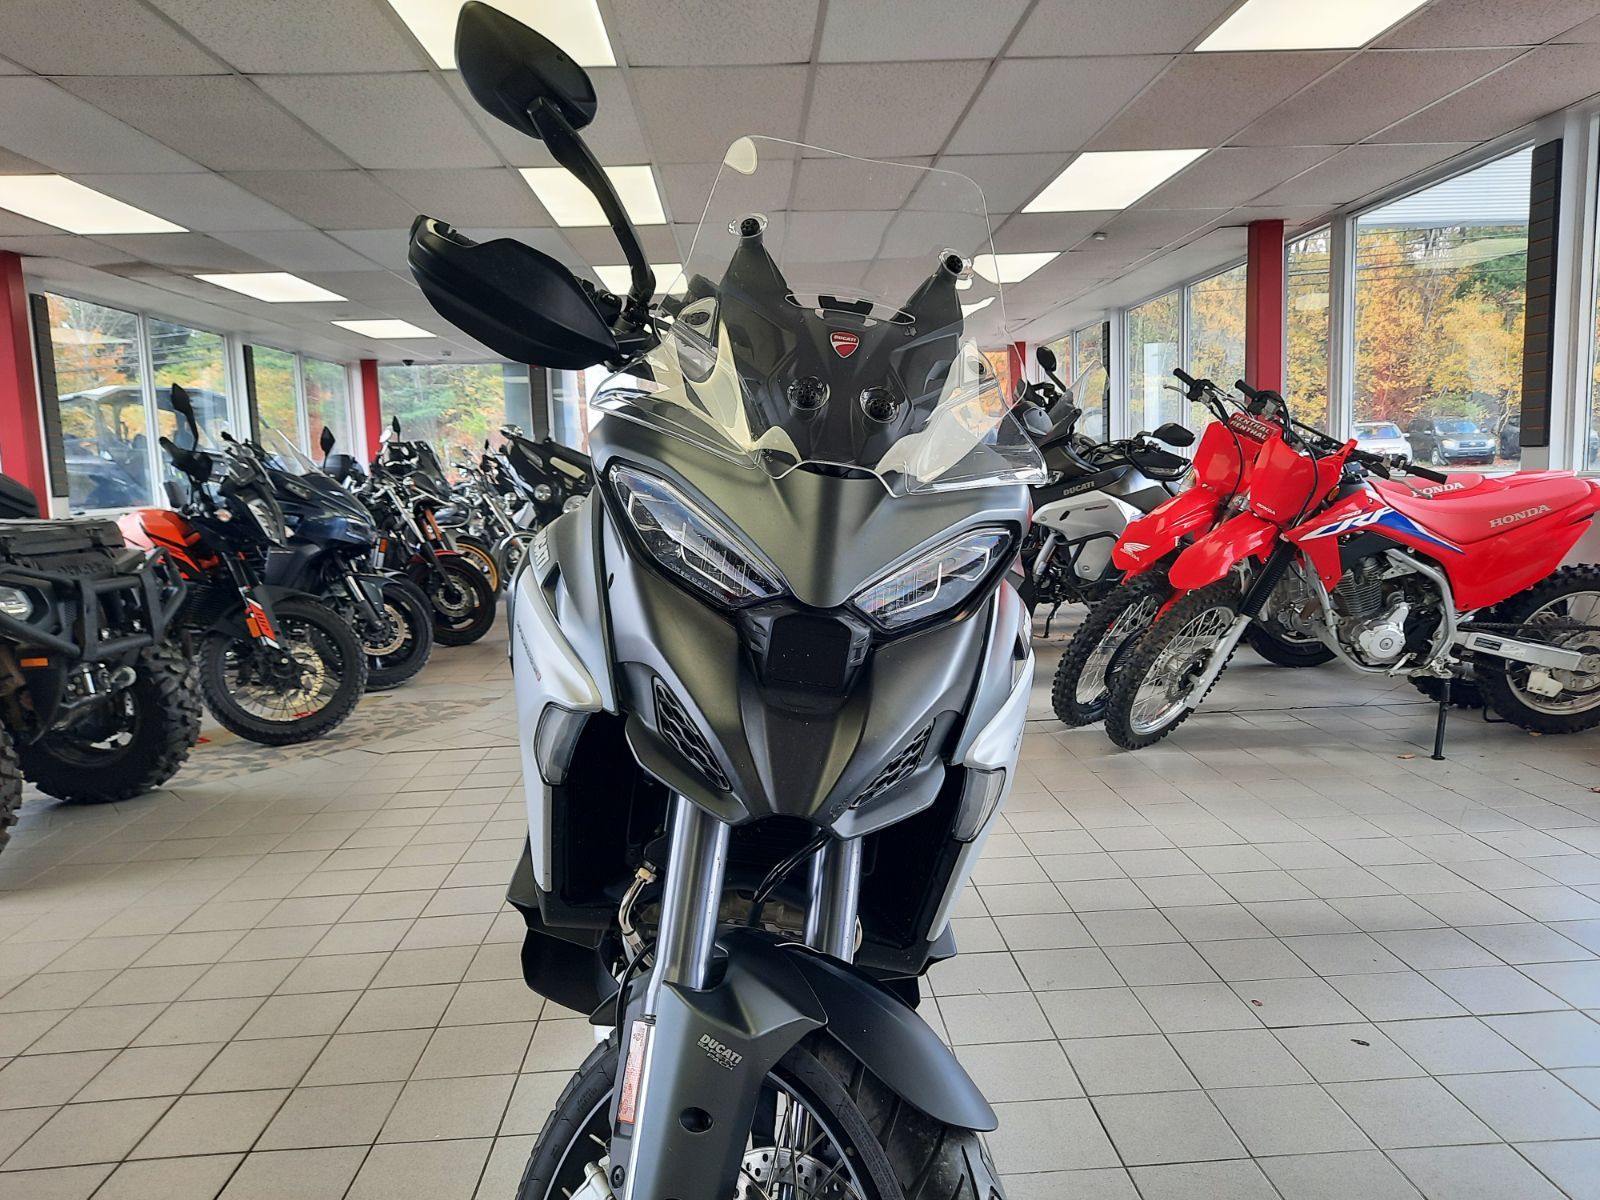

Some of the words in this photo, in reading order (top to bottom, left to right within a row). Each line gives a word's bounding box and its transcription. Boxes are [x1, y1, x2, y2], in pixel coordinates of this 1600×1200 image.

[833, 334, 858, 343] DUCATI
[1230, 420, 1268, 440] RENTHAL
[1233, 414, 1271, 434] RENTHAL
[1063, 480, 1096, 496] DUCATI
[1298, 506, 1395, 541] CRF
[1489, 504, 1551, 529] HONDA
[699, 1033, 743, 1064] DUCATI
